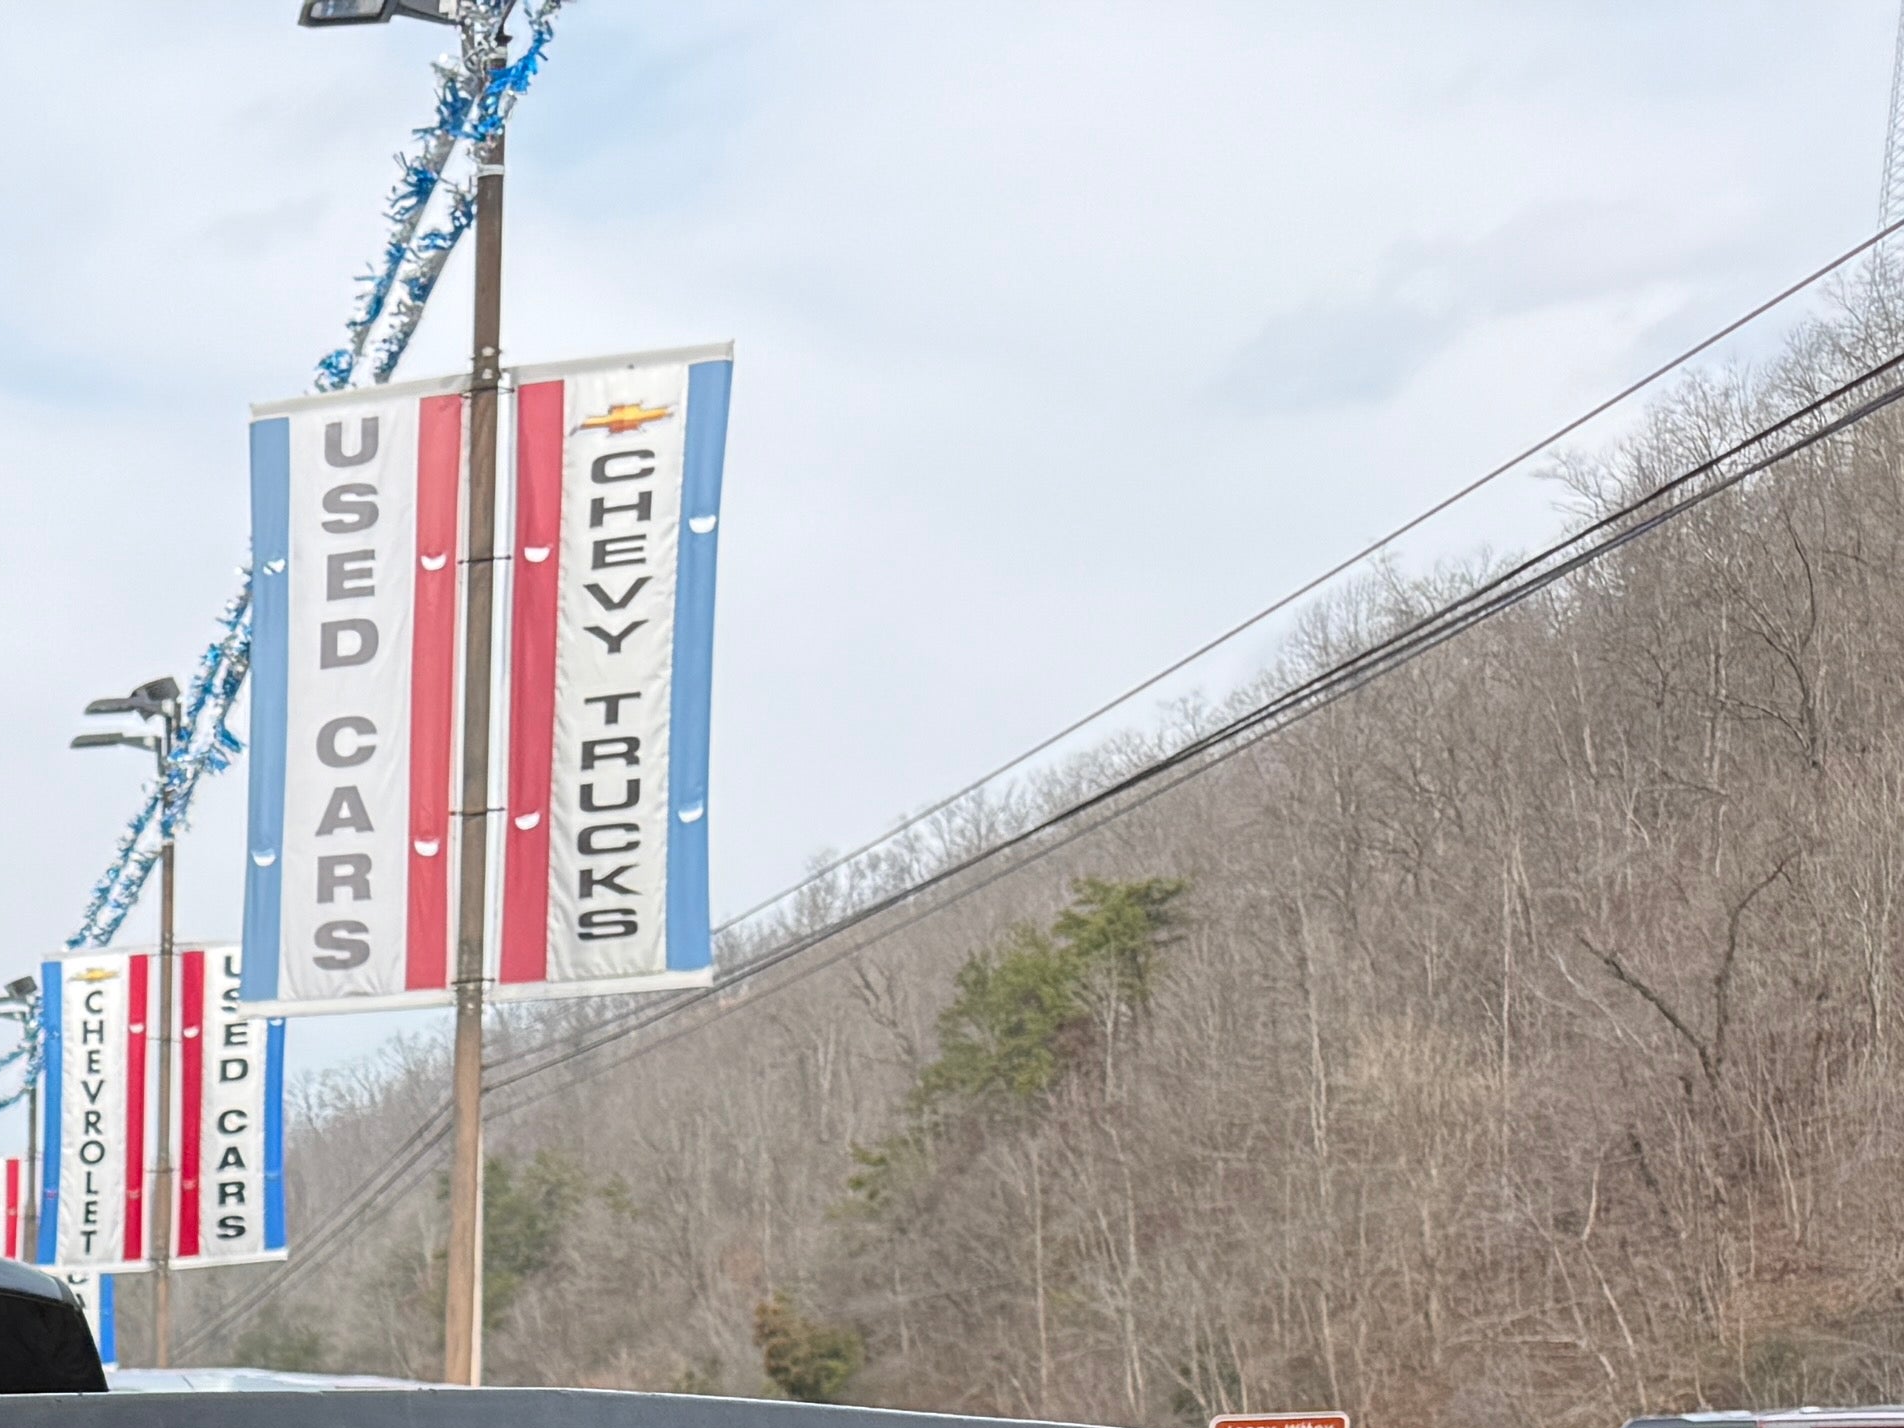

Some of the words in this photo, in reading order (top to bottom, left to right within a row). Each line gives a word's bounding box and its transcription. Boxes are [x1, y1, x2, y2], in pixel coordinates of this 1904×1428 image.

[320, 416, 380, 670] USED
[582, 450, 657, 655] CHEVY
[313, 716, 379, 971] CARS
[577, 691, 642, 942] TRUCKS
[79, 990, 106, 1256] CHEVROLET
[216, 1109, 249, 1240] CARS
